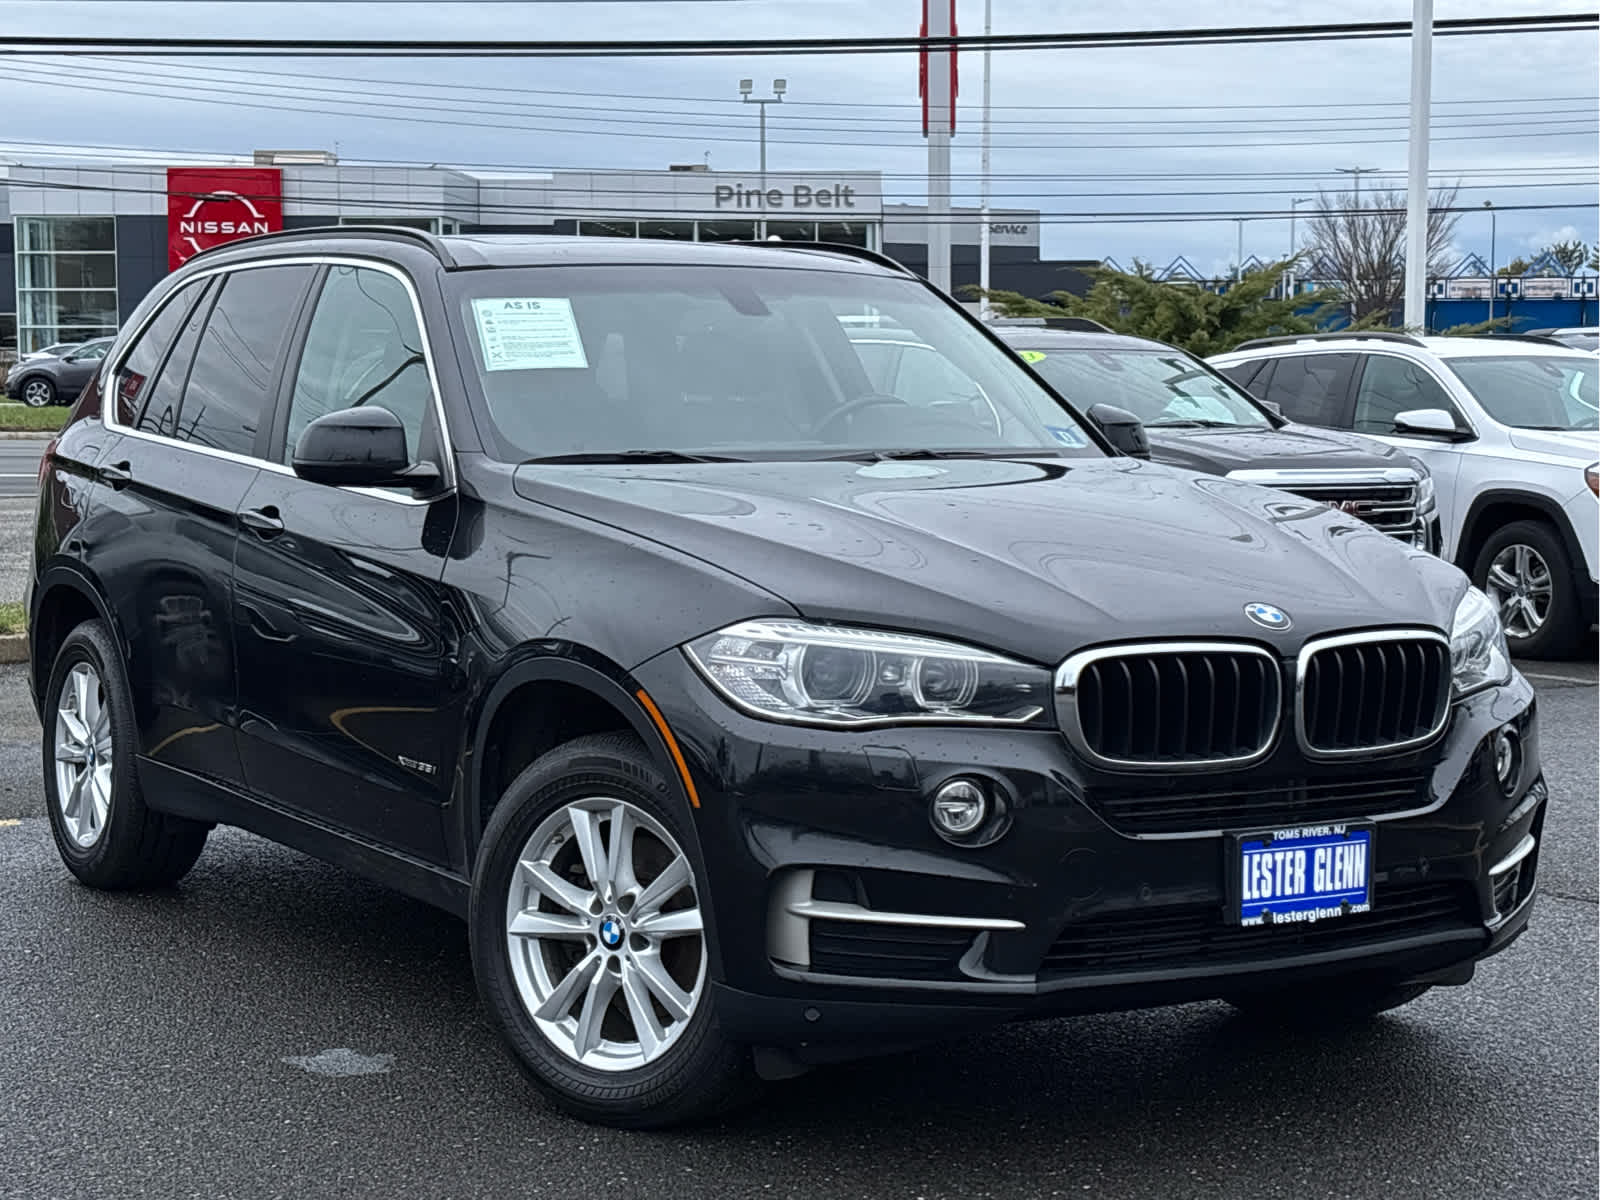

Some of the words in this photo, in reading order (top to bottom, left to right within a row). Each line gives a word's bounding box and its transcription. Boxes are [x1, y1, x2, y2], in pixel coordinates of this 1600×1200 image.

[715, 183, 783, 208] Pine
[793, 183, 855, 208] Belt
[180, 221, 269, 234] NISSAN
[503, 301, 523, 310] AS
[527, 301, 541, 310] IS
[1273, 829, 1300, 840] TOMS
[1333, 823, 1346, 834] NJ
[1242, 849, 1306, 900] LESTER
[1313, 843, 1366, 893] GLENN
